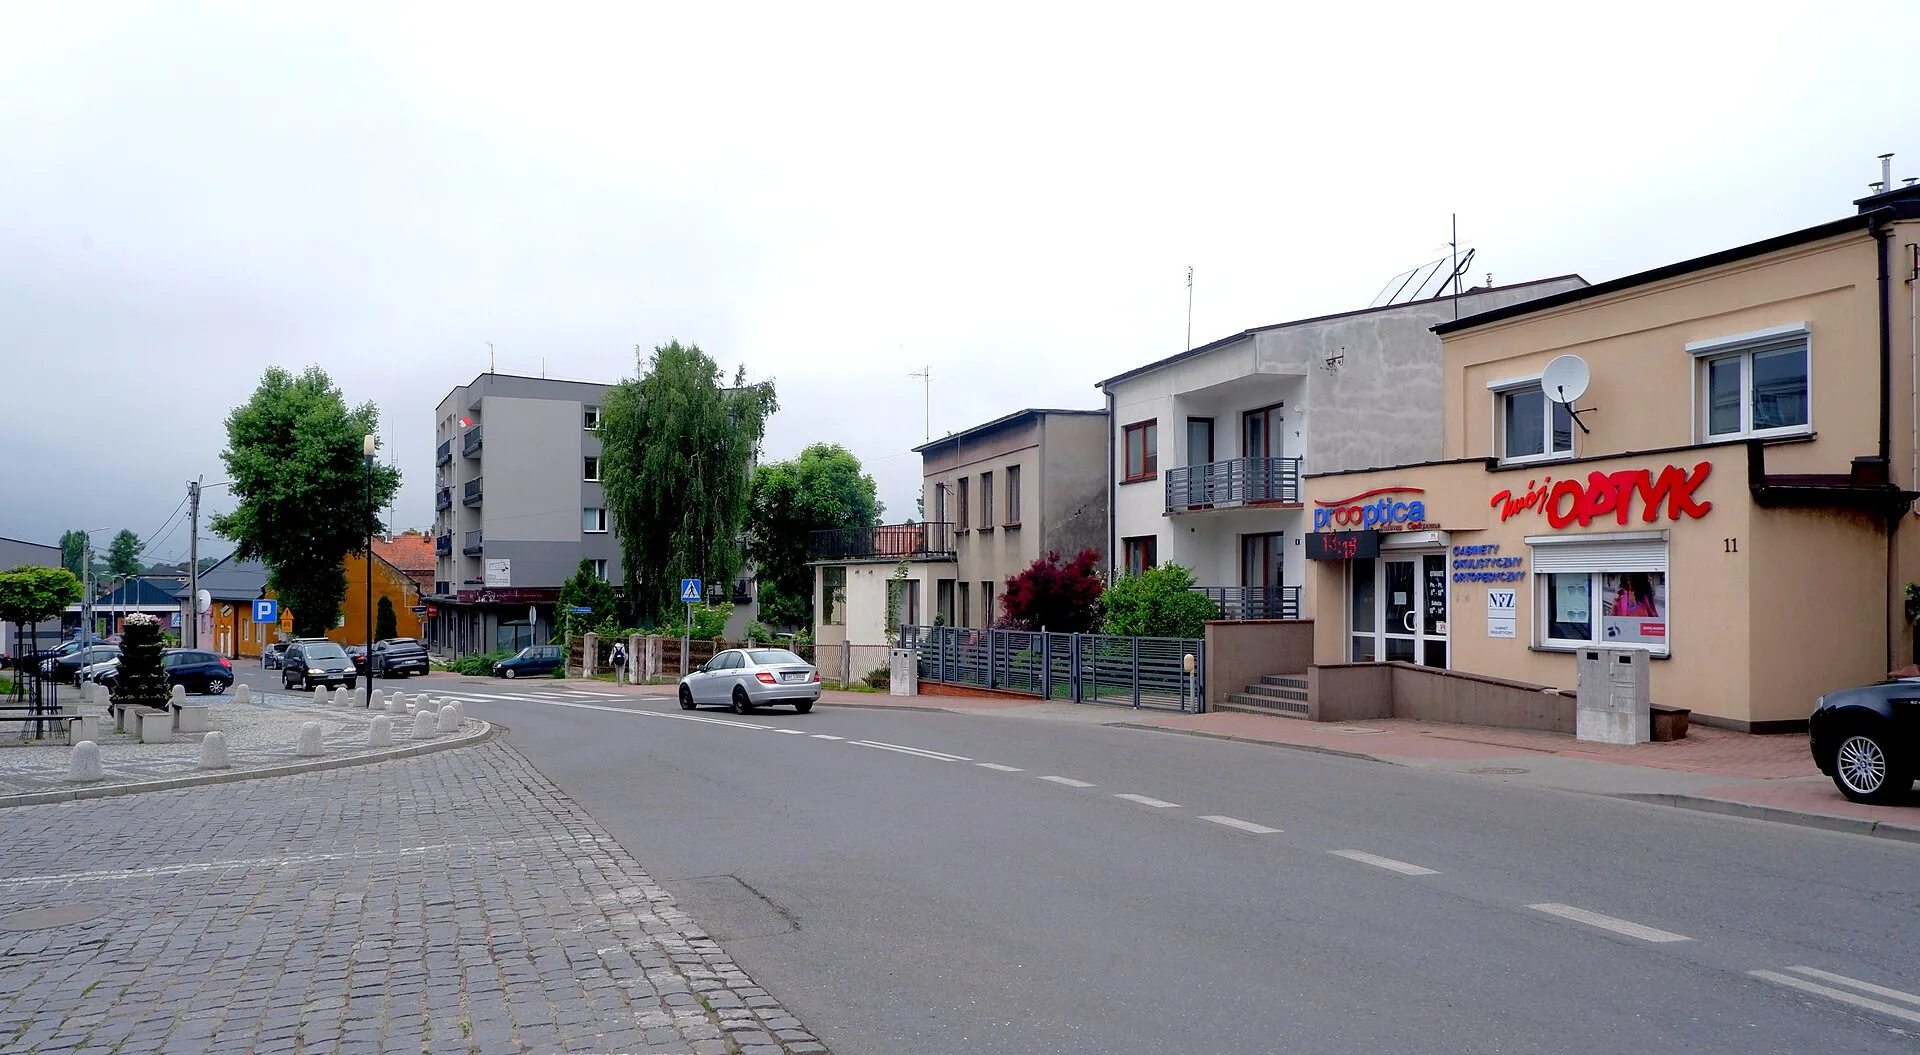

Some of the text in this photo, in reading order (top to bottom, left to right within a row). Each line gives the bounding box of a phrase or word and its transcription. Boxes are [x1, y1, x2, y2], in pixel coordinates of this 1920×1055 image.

[1546, 461, 1713, 529] OPTYK
[1313, 497, 1425, 533] prooptica
[1452, 544, 1500, 556] GABINETY
[1724, 537, 1738, 553] 11
[1452, 557, 1523, 570] OKULISTYCZNY
[1452, 571, 1526, 583] ORTOPEDYCZNY
[1489, 593, 1515, 608] NFZ
[258, 602, 271, 619] P
